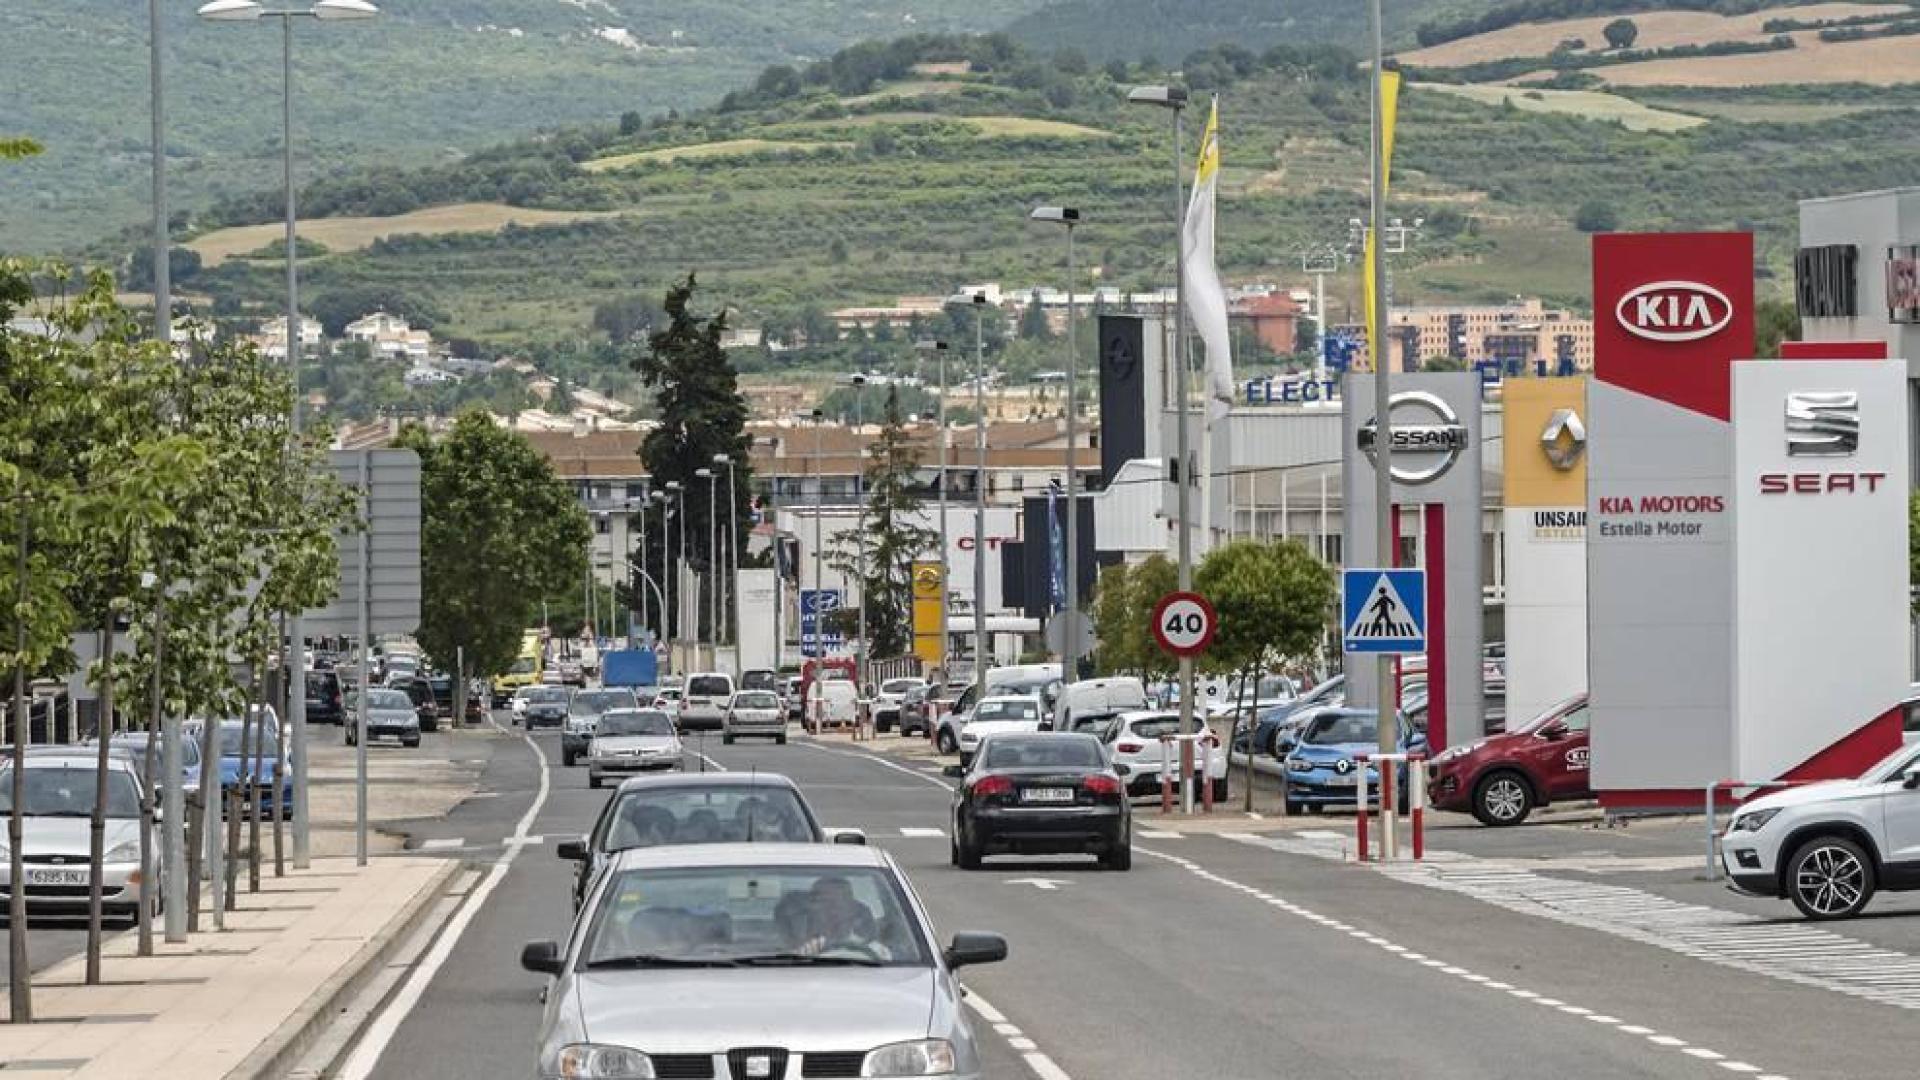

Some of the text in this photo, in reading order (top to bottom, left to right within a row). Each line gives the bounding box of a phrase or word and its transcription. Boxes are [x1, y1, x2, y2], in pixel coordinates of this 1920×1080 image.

[1636, 295, 1713, 326] KIA
[1760, 473, 1886, 493] SEAT
[1600, 496, 1724, 513] KIA MOTORS
[1600, 521, 1702, 536] Estella Motor
[1166, 613, 1203, 634] 40
